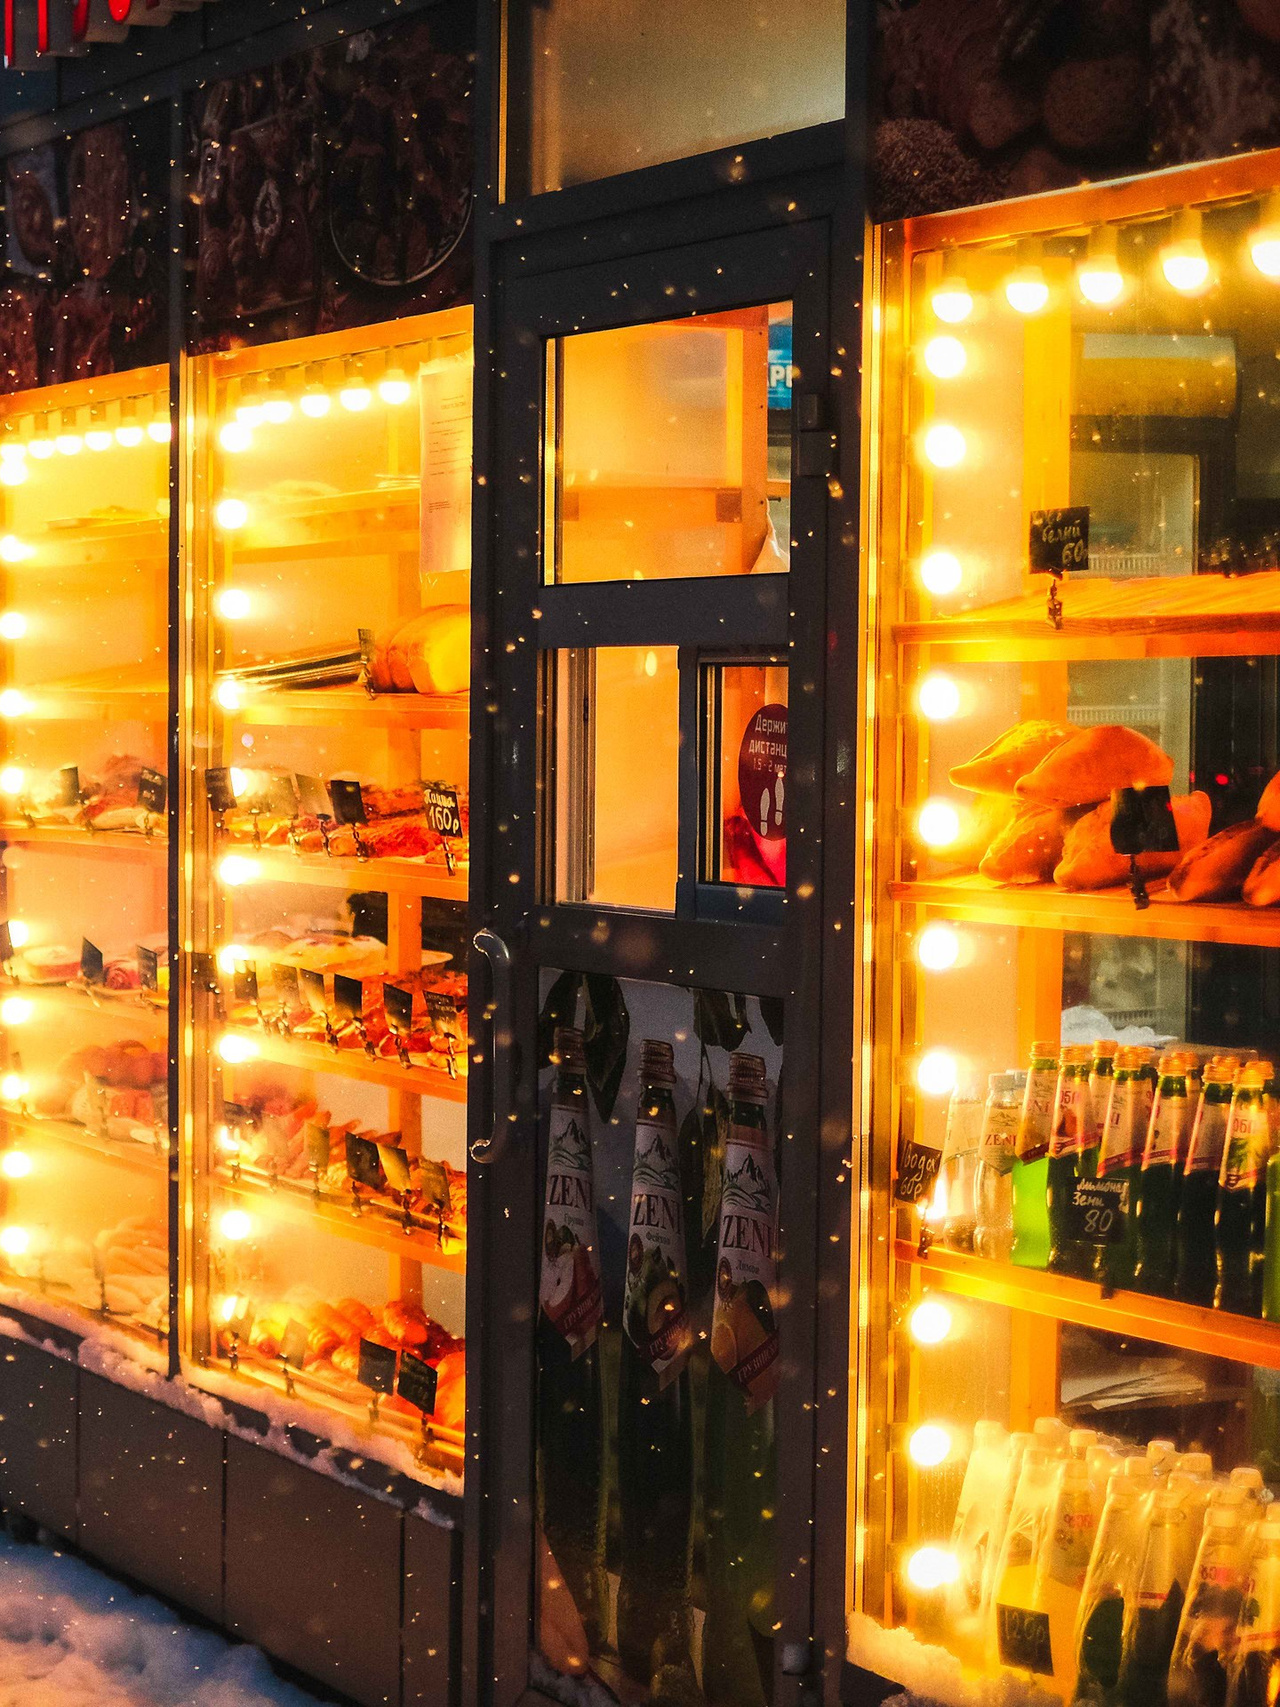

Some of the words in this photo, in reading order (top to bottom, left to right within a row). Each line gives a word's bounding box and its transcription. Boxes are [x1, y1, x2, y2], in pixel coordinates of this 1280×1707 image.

[754, 713, 788, 737] Держи
[549, 1174, 593, 1214] ZENI
[632, 1193, 681, 1235] ZENI
[722, 1214, 772, 1258] ZENI
[1084, 1209, 1114, 1232] 80
